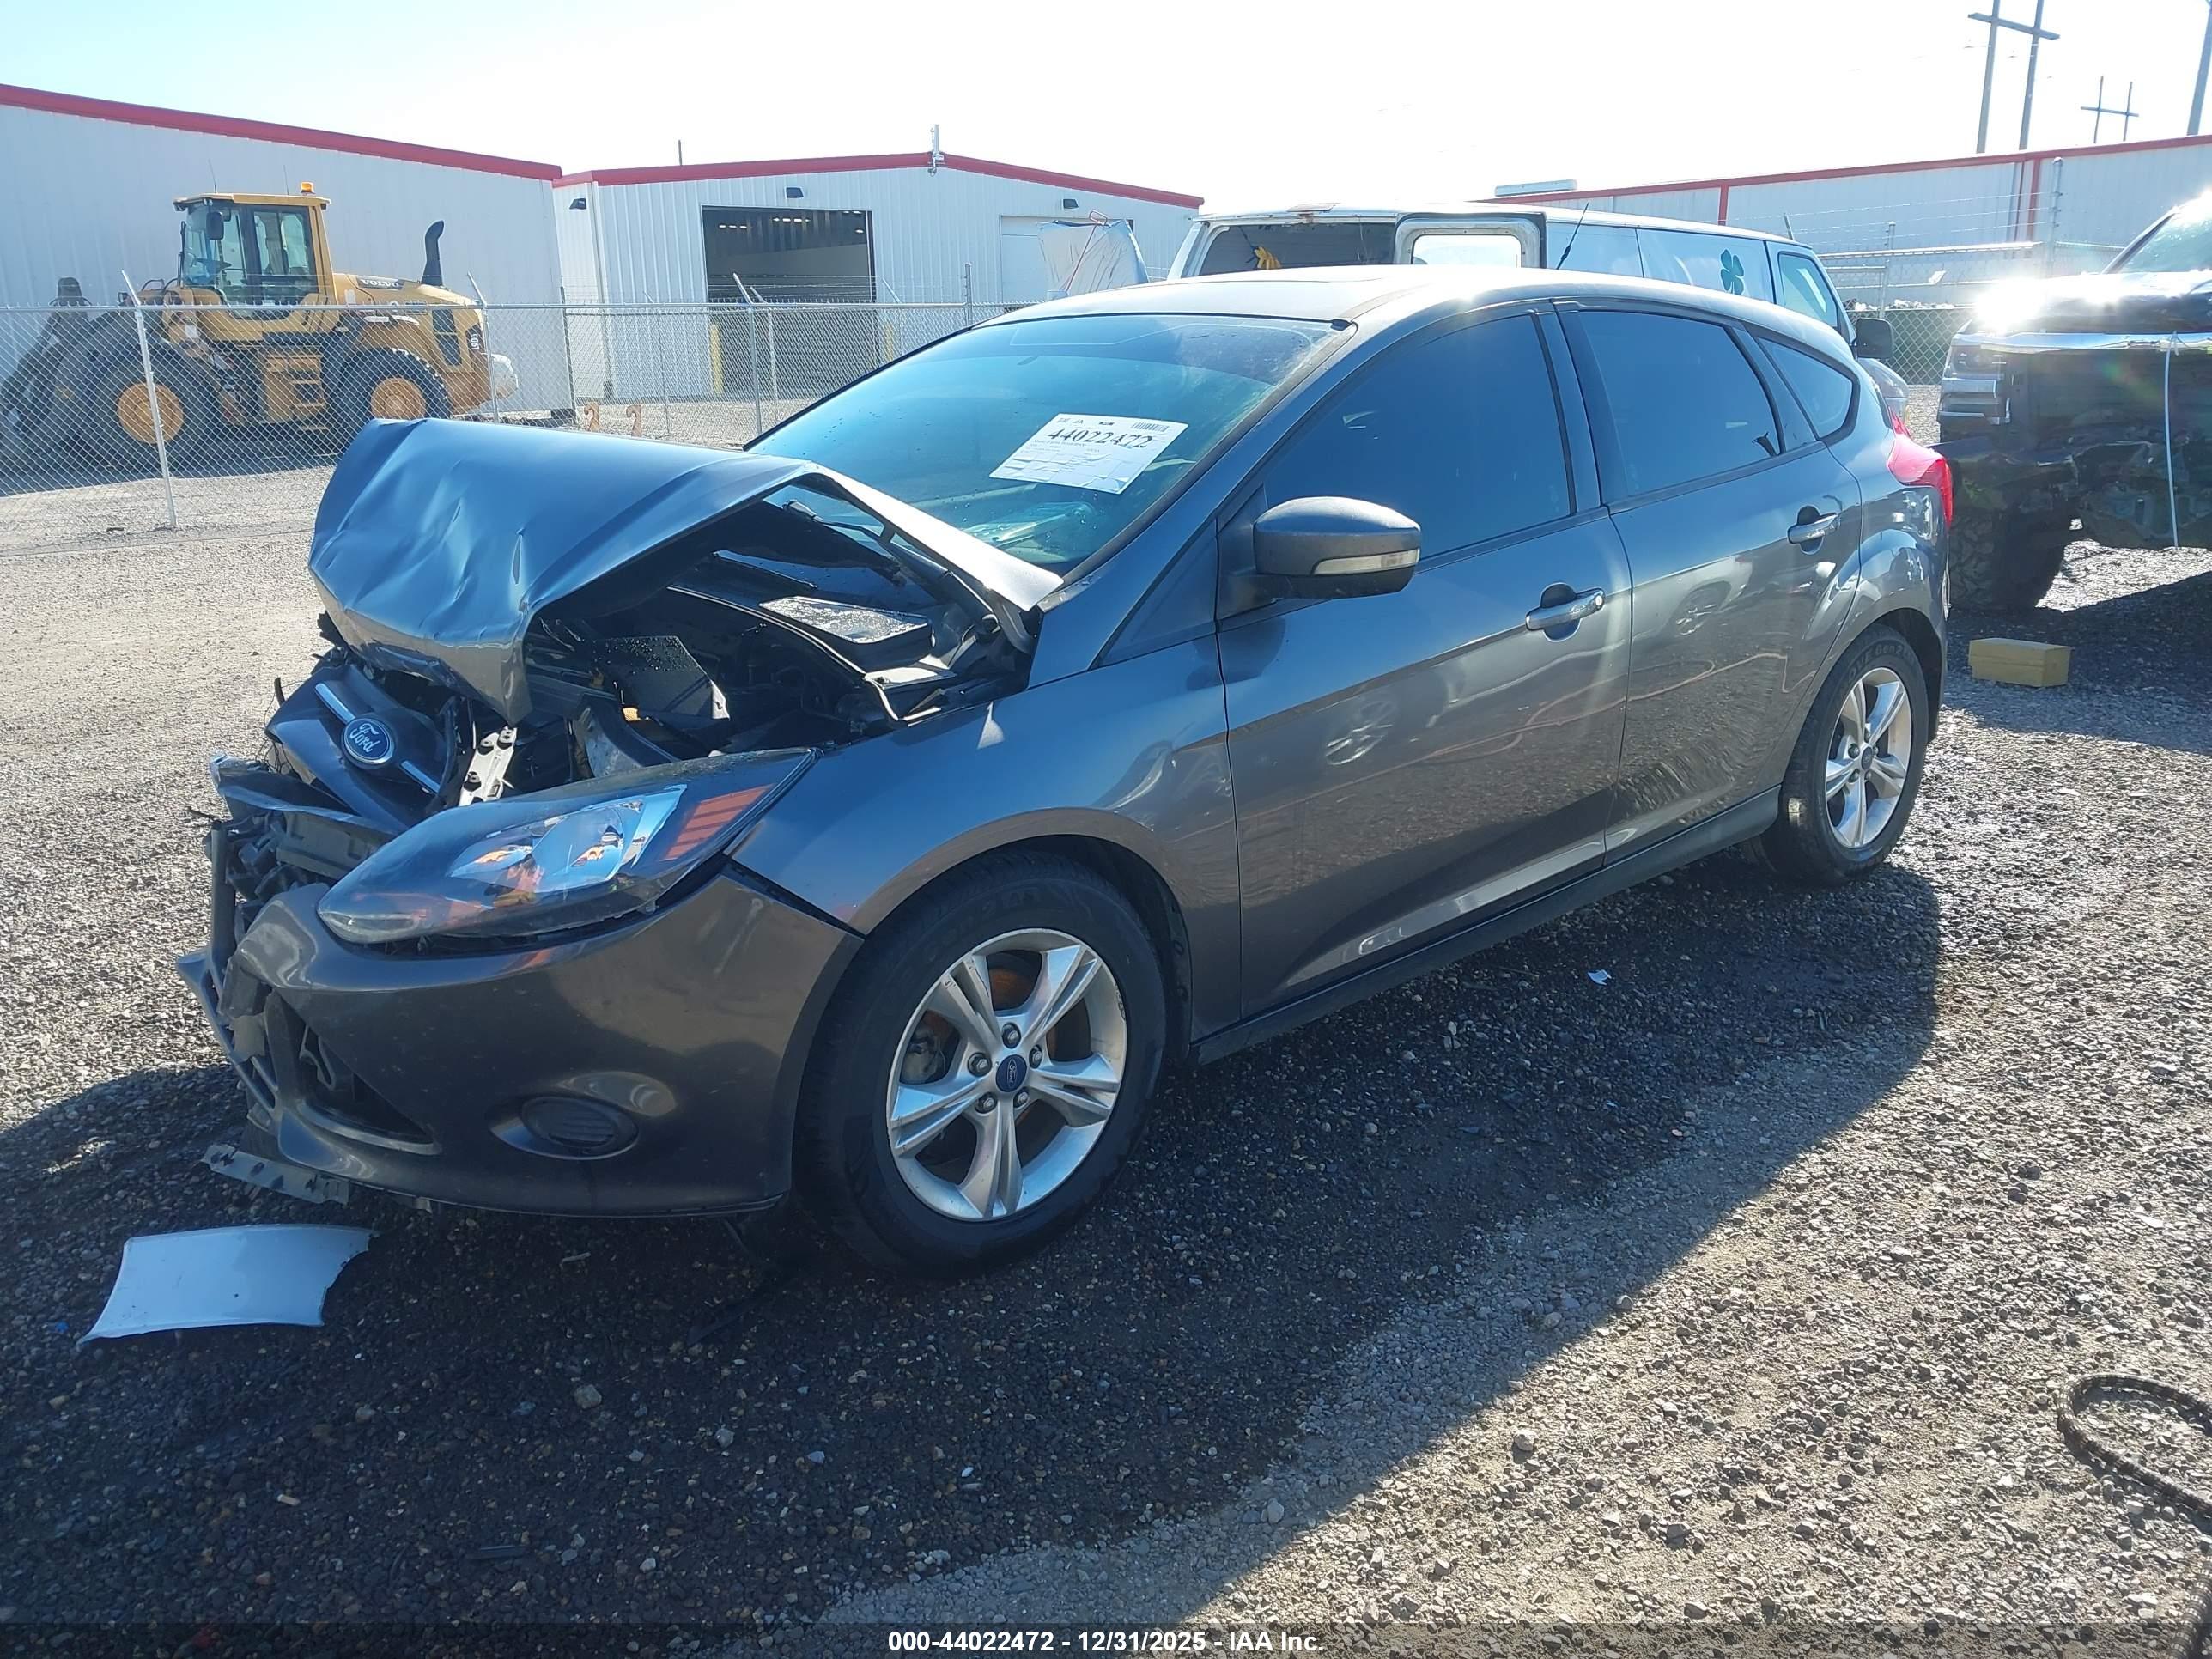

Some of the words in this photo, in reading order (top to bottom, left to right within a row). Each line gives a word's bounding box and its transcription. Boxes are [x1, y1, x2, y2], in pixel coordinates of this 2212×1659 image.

[361, 279, 399, 288] VOLVO
[1047, 428, 1153, 448] 44022472
[349, 723, 381, 753] Ford
